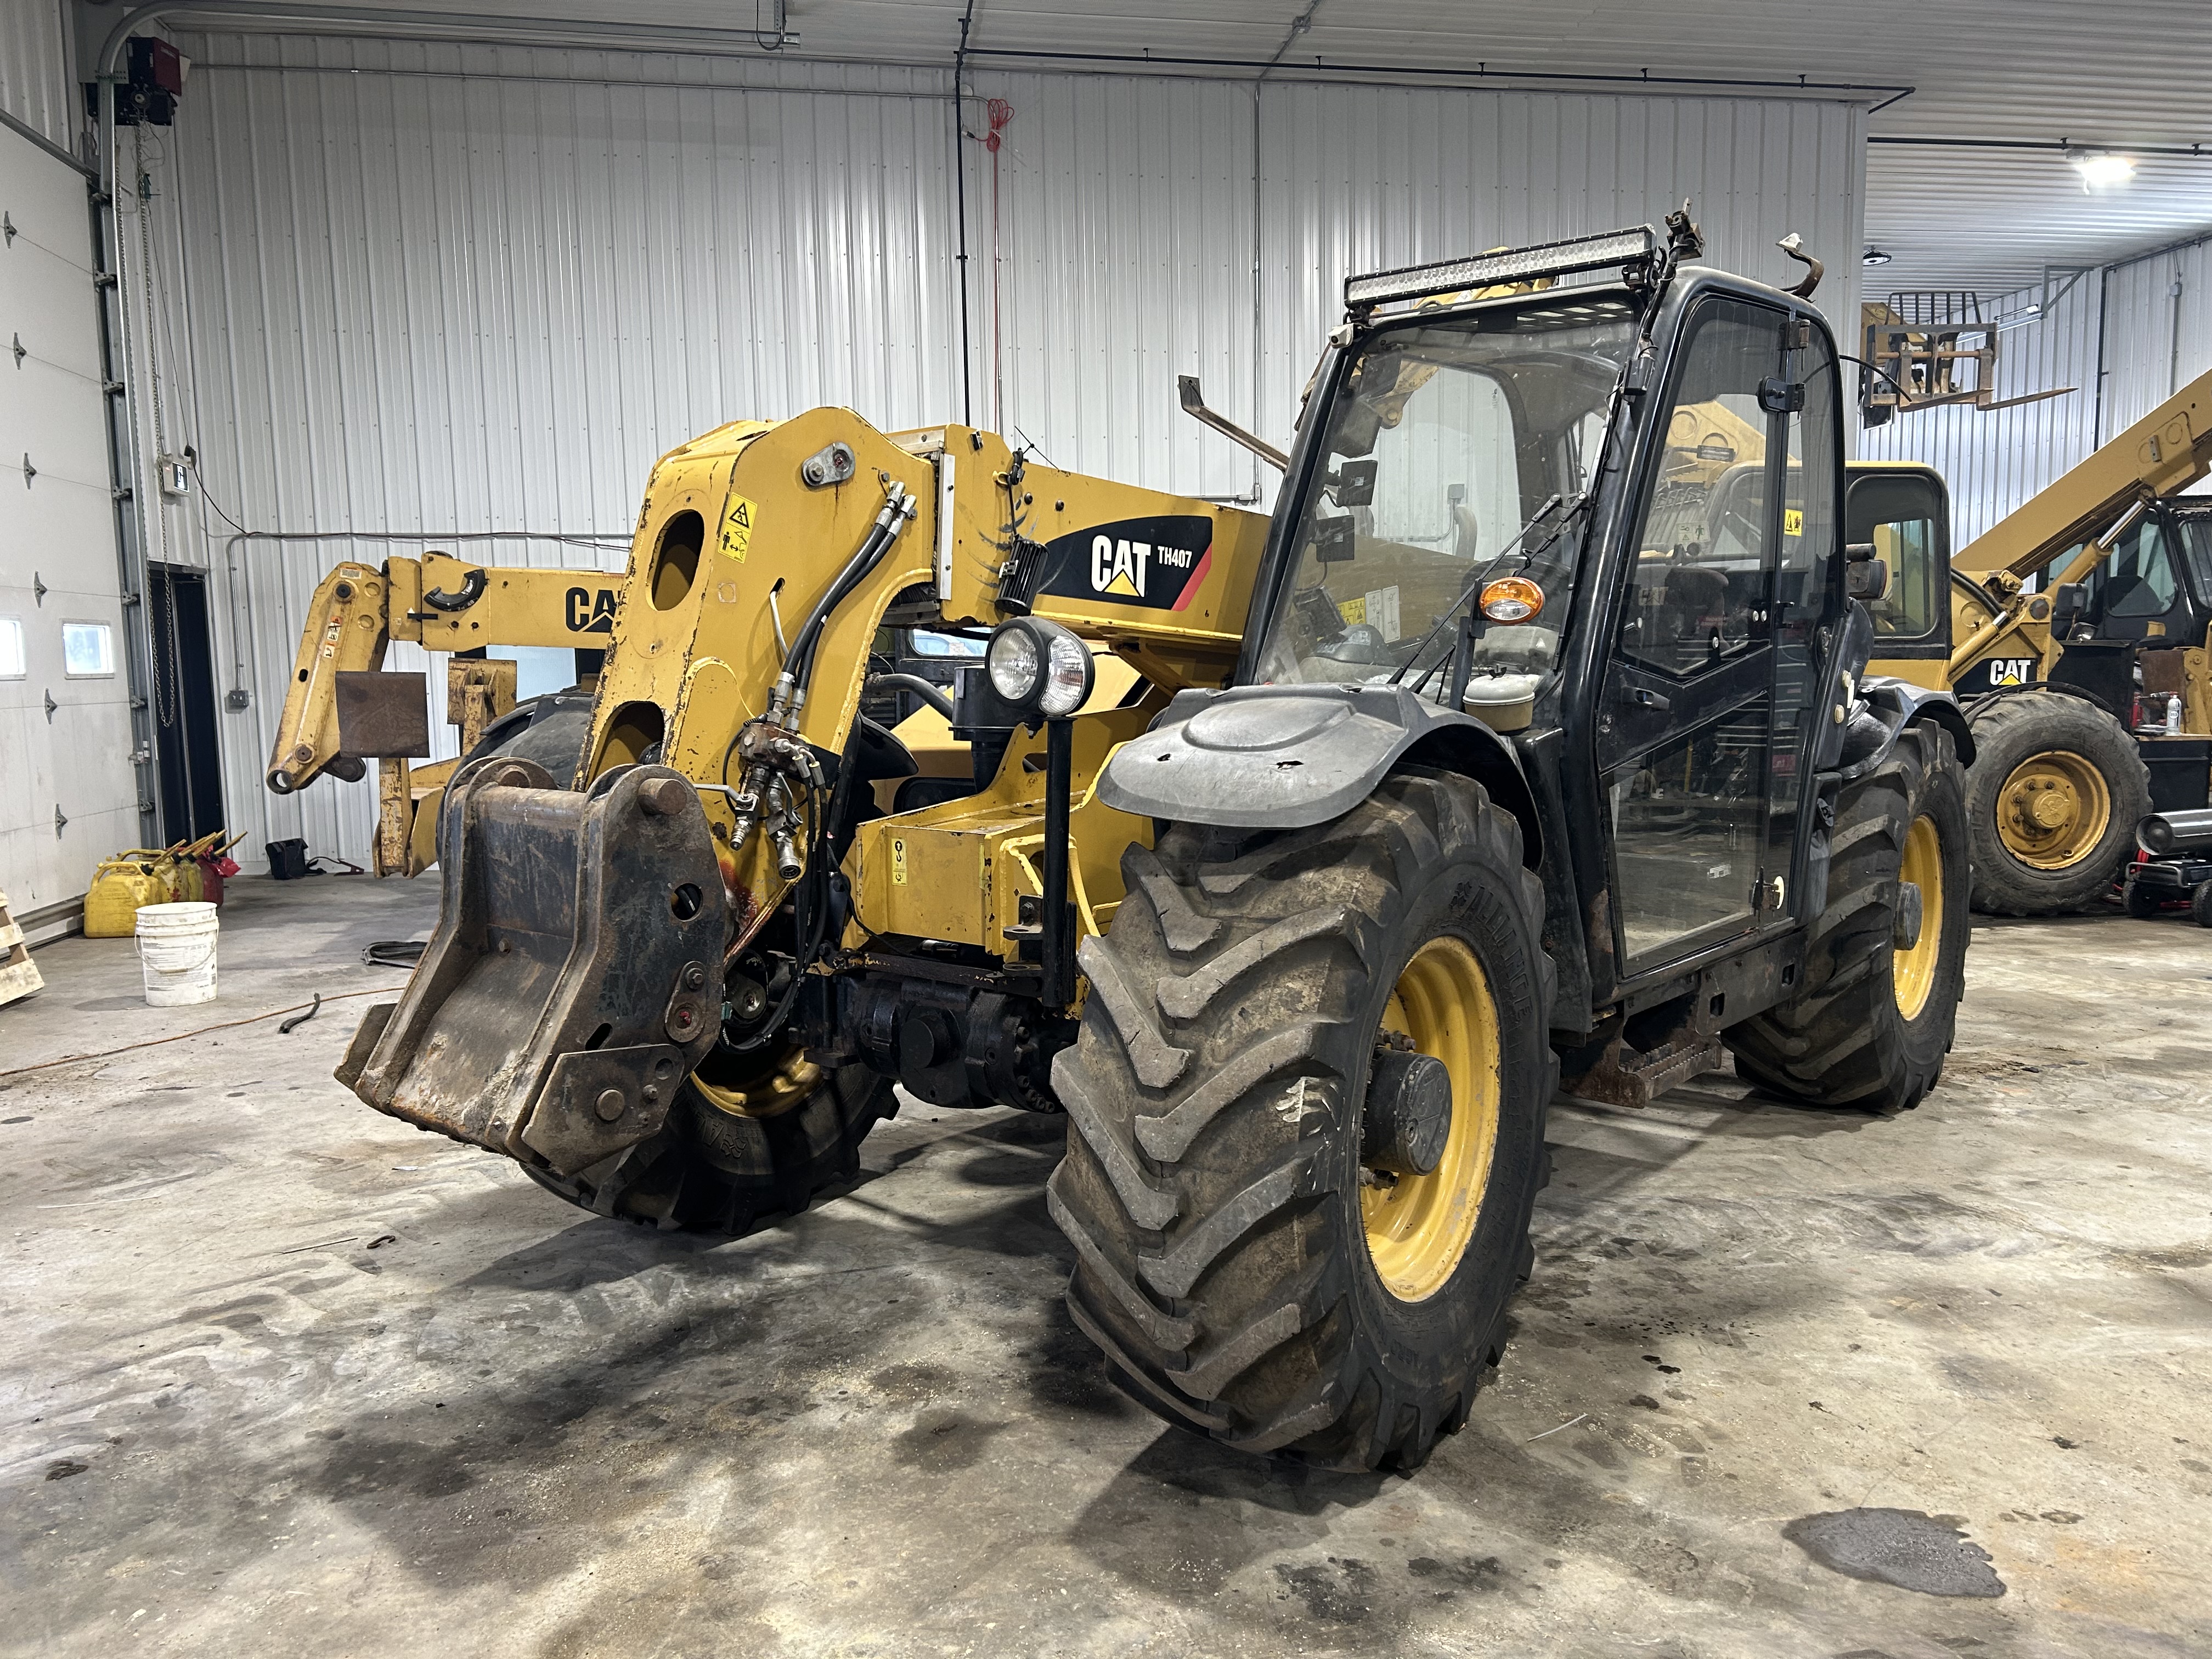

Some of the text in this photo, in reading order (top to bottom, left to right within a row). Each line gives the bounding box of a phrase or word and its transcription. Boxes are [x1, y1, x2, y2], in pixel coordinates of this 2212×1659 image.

[1091, 534, 1193, 597] CAT TH407
[566, 587, 620, 632] CA
[1989, 659, 2031, 686] CAT
